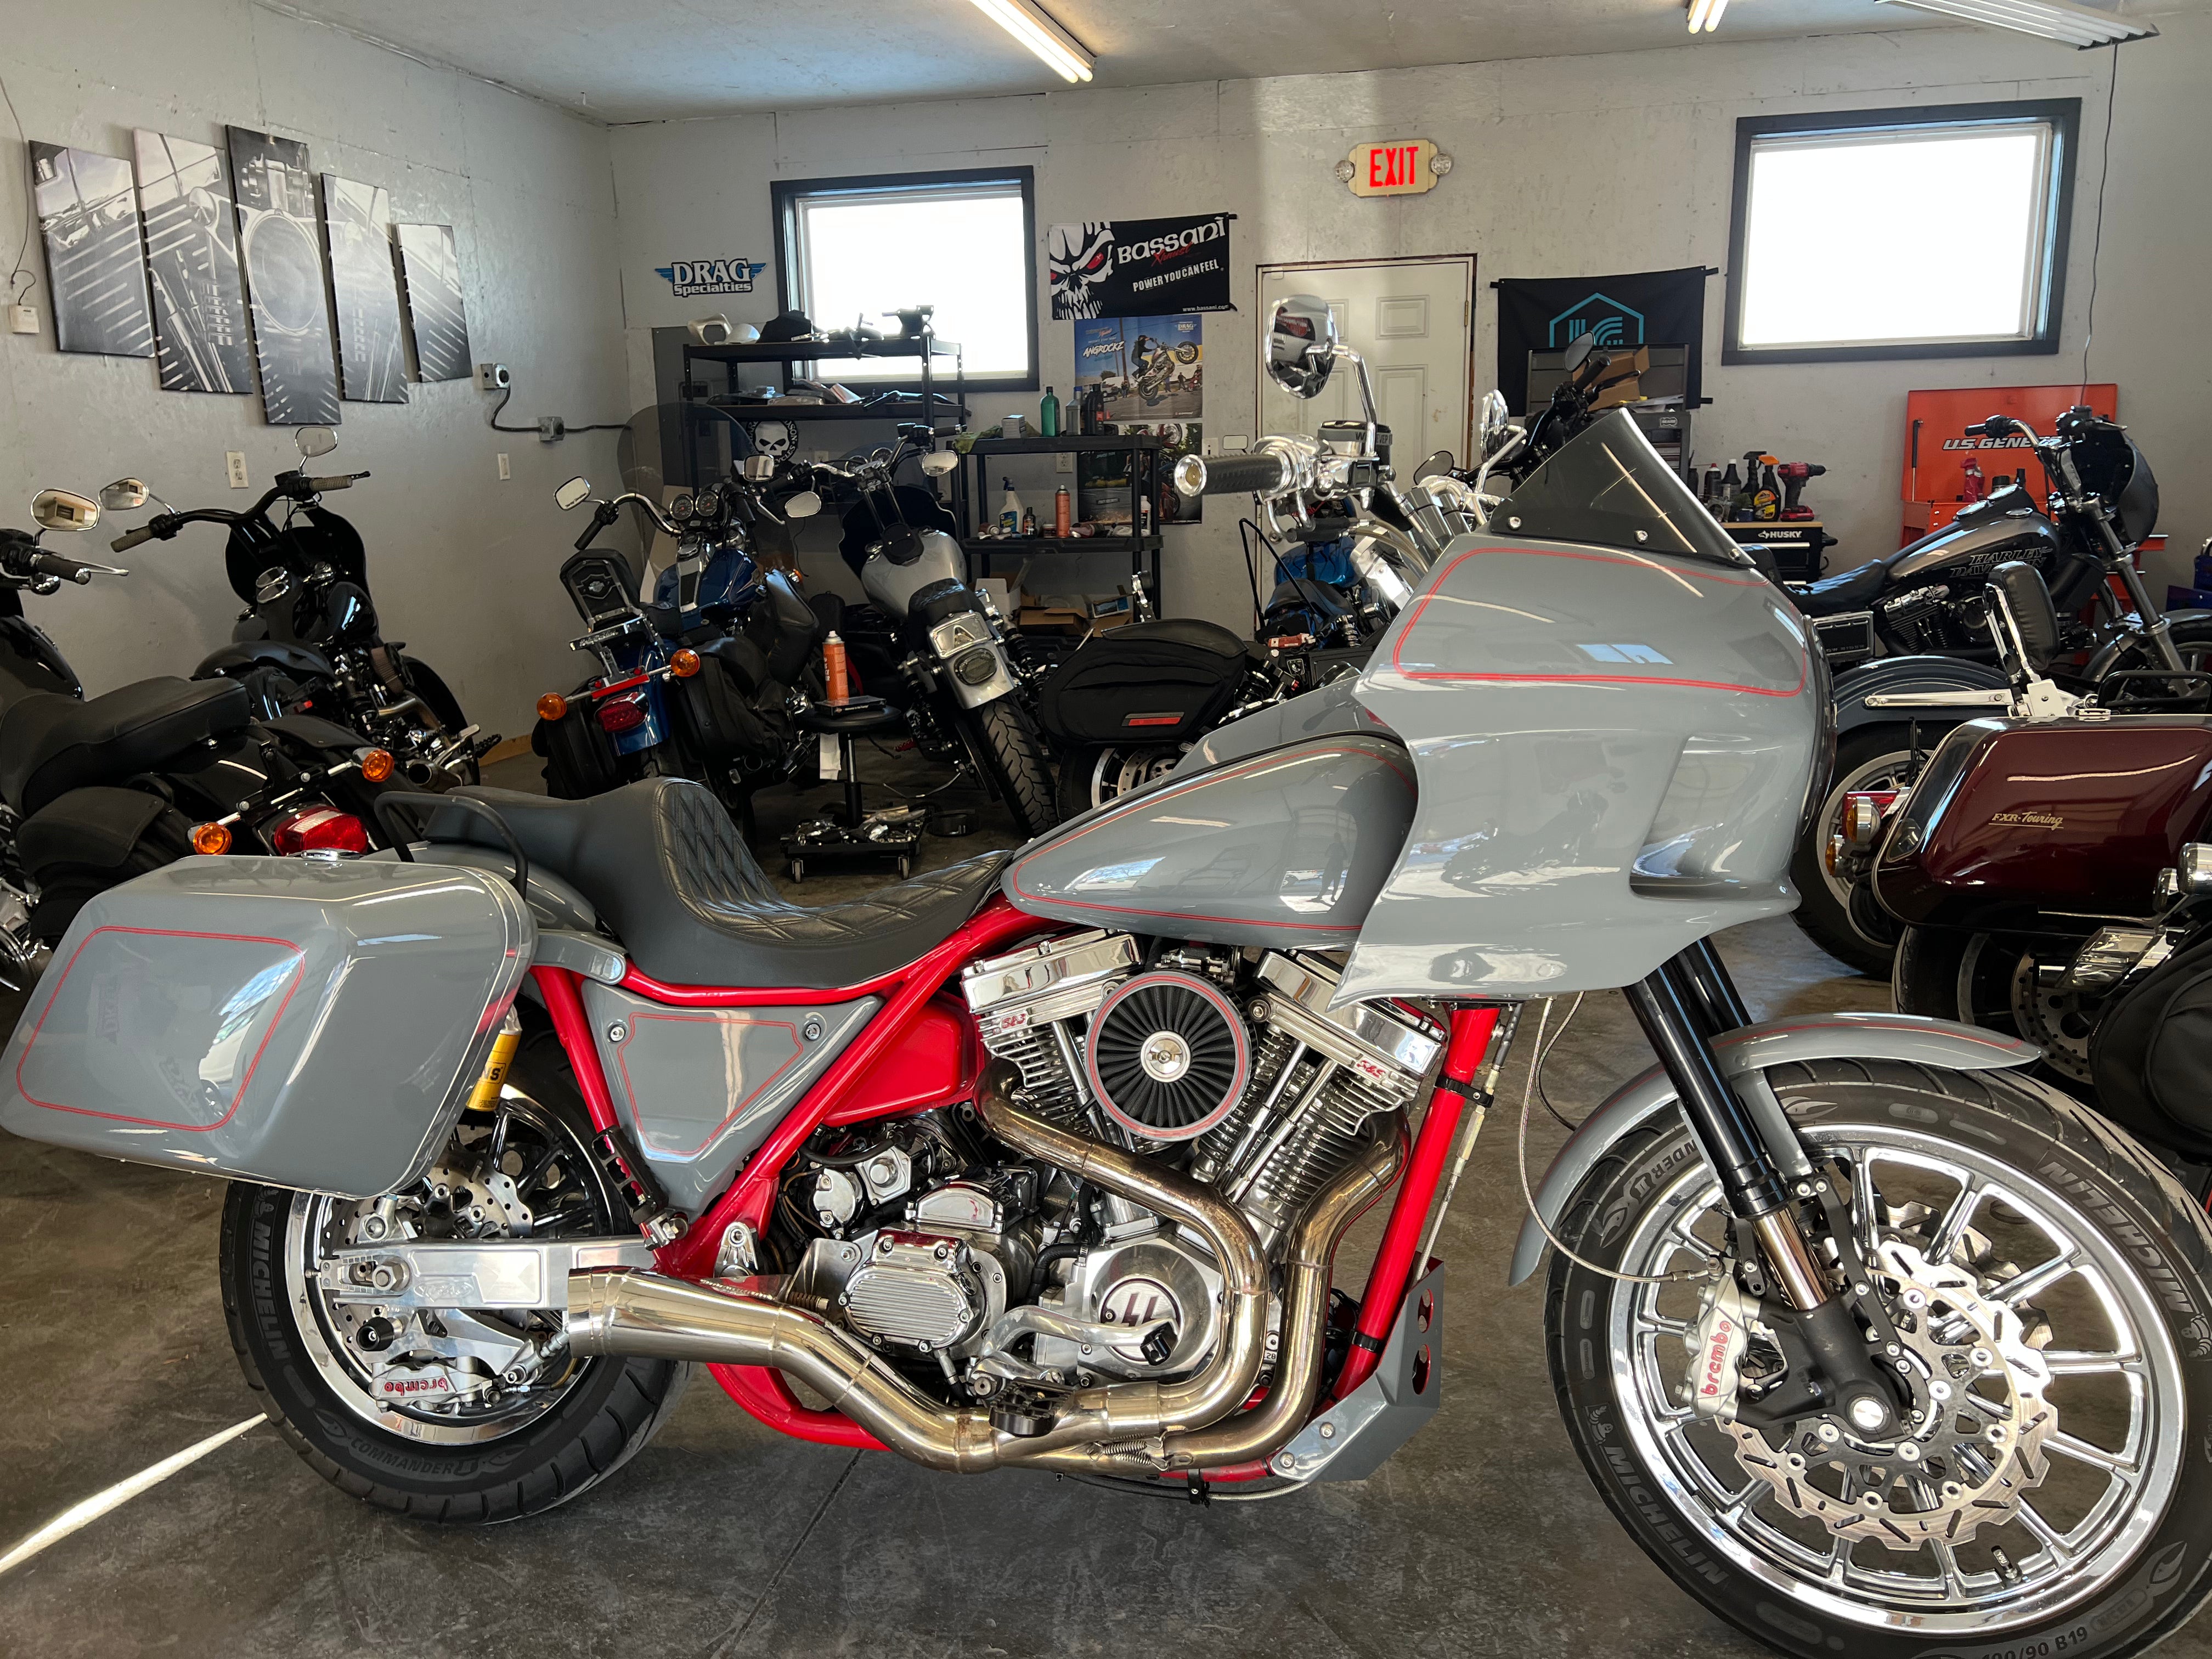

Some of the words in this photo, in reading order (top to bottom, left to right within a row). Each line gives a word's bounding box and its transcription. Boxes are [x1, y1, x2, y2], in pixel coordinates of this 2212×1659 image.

[1369, 146, 1419, 188] EXIT
[672, 258, 751, 284] DRAG
[1132, 275, 1164, 292] POWER
[1164, 270, 1181, 284] YOU
[1182, 264, 1200, 278] CAN
[1200, 258, 1219, 273] FEEL
[674, 283, 752, 296] Specialties
[1943, 438, 1976, 450] U.S.
[2038, 1161, 2194, 1313] MICHELIN
[252, 1221, 292, 1360] MICHELIN
[1700, 1320, 1732, 1396] brembo
[384, 1376, 449, 1396] brembo
[350, 1437, 454, 1475] COMMANDER
[1603, 1446, 1729, 1585] MICHELIN
[2054, 1626, 2088, 1651] B19
